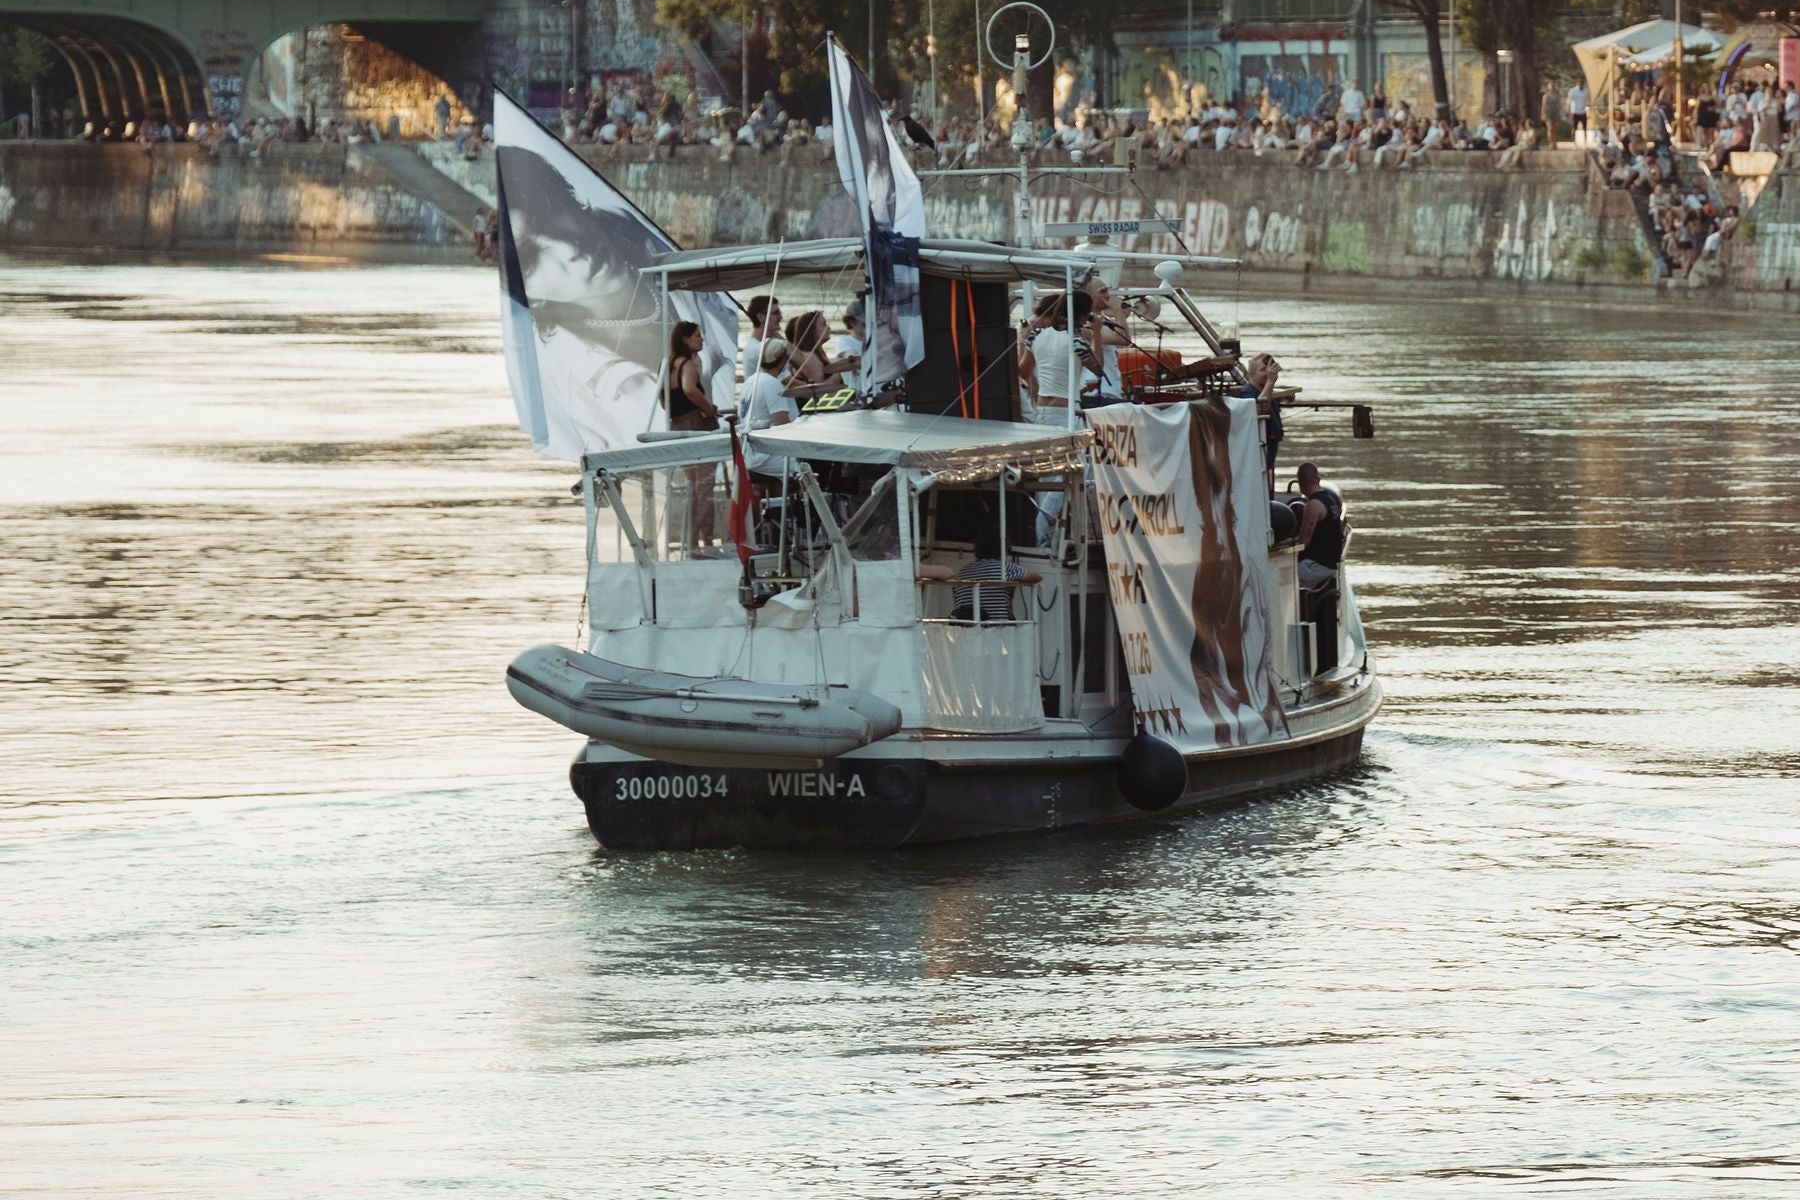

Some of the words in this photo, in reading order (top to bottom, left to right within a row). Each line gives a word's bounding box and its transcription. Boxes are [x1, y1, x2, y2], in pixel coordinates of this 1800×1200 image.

[1088, 223, 1112, 234] SWISS
[1114, 222, 1140, 233] RADAR
[615, 774, 728, 800] 30000034
[767, 773, 866, 797] WIEN-A
